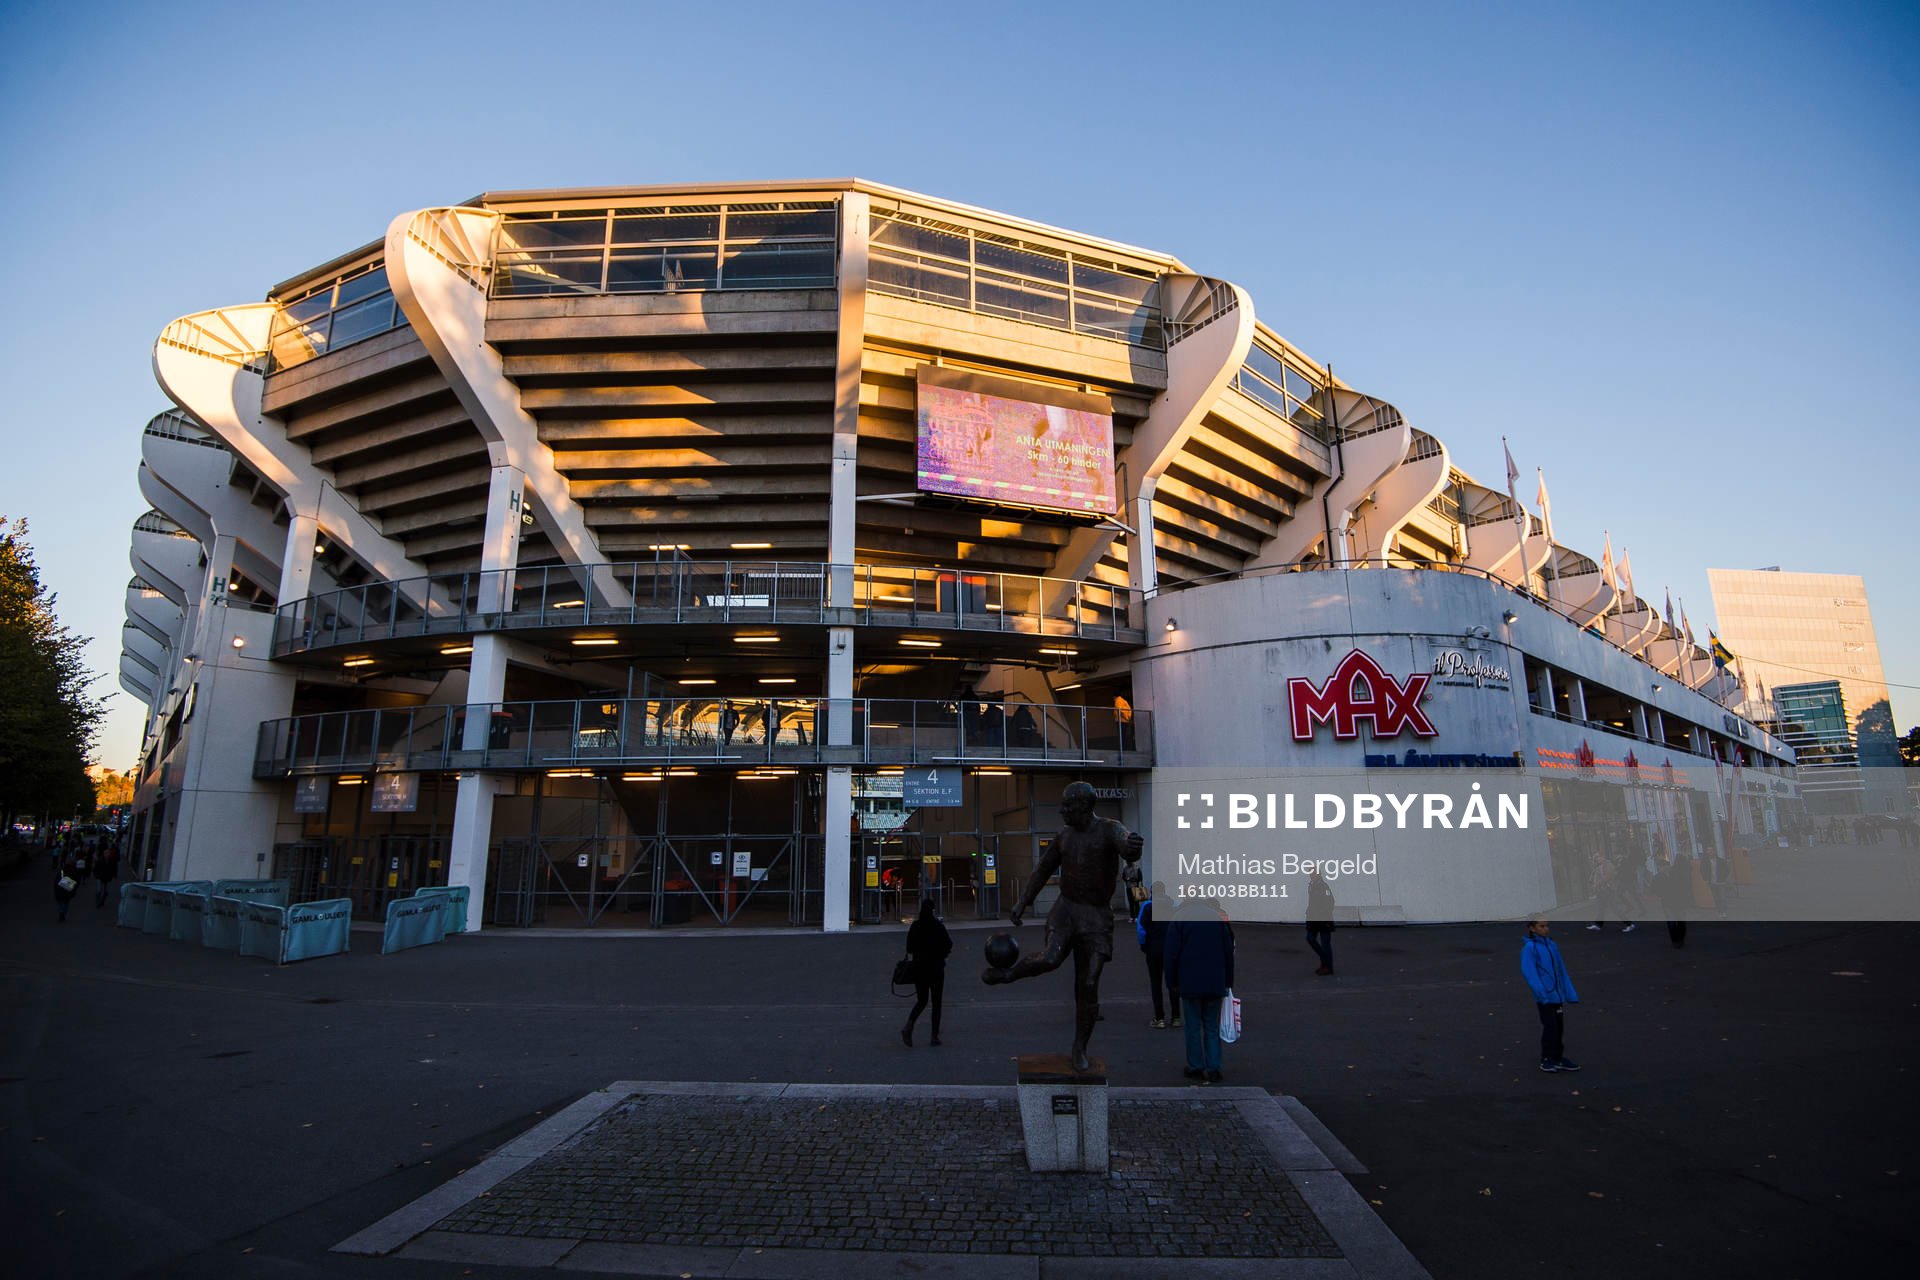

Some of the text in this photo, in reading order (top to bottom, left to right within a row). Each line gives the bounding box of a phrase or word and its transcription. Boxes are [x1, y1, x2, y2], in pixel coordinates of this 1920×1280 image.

[1016, 435, 1042, 448] ANTA
[1027, 450, 1048, 461] 5km
[1057, 455, 1069, 465] 60
[1071, 456, 1101, 469] hinder
[510, 490, 520, 512] H
[213, 576, 226, 592] H
[1287, 648, 1440, 741] MAX
[391, 775, 400, 790] 4
[927, 768, 938, 784] 4
